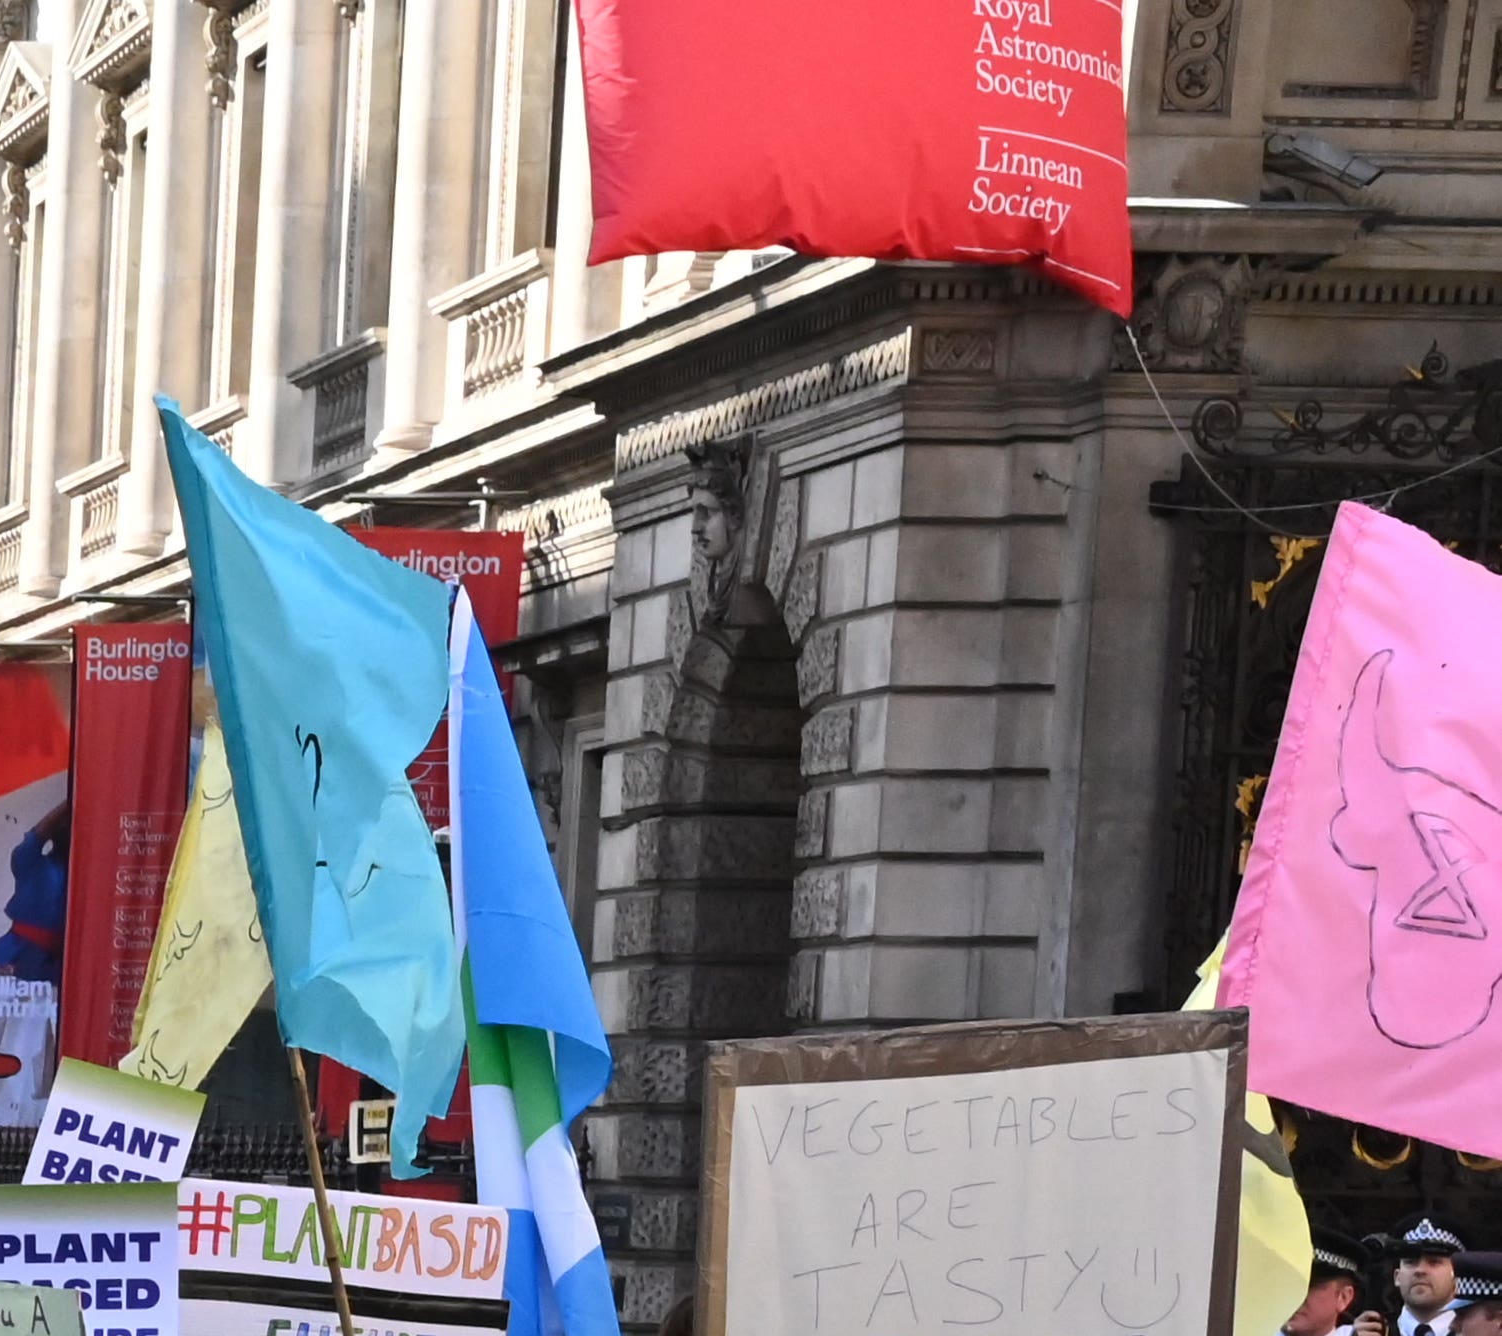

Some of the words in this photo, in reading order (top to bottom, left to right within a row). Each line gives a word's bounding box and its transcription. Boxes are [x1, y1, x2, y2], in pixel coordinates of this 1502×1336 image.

[976, 59, 1073, 118] Society
[975, 136, 1083, 189] Linnean
[968, 177, 1071, 236] Society
[392, 549, 500, 578] rlington
[85, 663, 159, 682] House
[86, 637, 189, 662] Burlingto
[54, 1108, 180, 1163] PLANT
[751, 1087, 1198, 1166] VEGETABLES
[178, 1190, 502, 1281] #PLANTBASED
[851, 1181, 996, 1249] ARE
[31, 1295, 51, 1336] A
[793, 1247, 1100, 1329] TASTY
